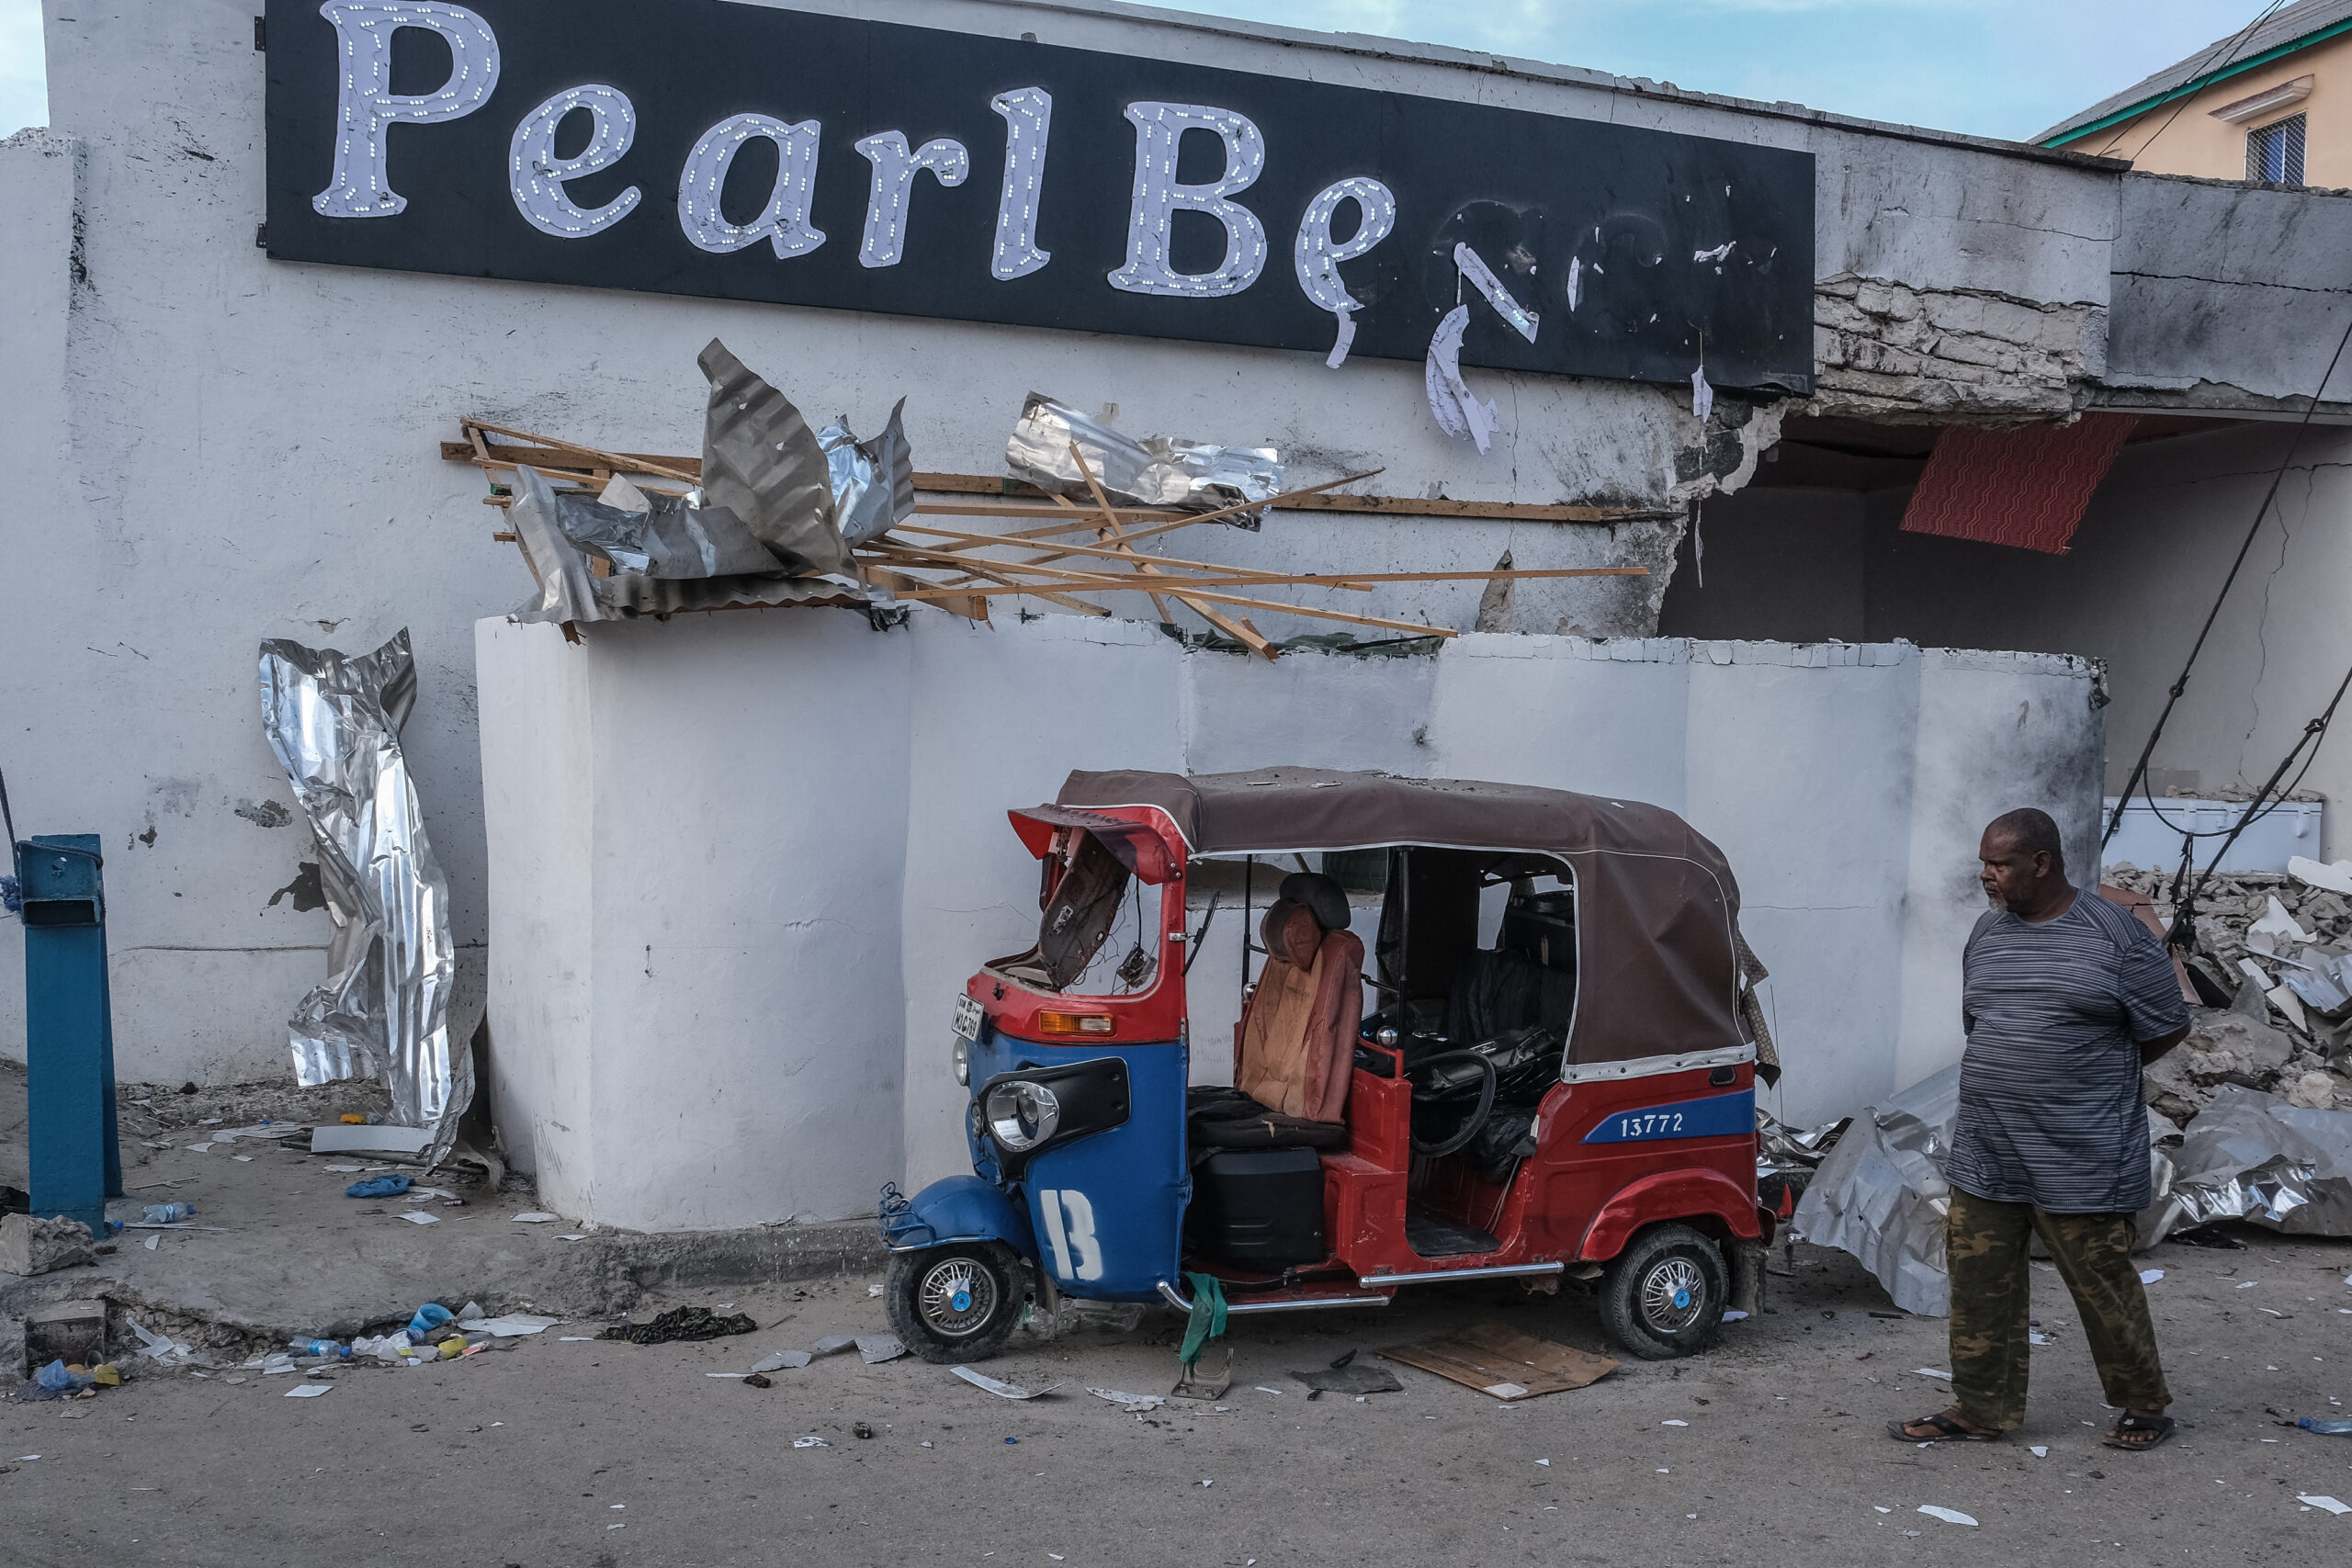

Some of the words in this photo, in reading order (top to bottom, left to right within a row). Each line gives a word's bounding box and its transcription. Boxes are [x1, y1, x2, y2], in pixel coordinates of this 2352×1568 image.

[311, 0, 1053, 281] Pearl
[1621, 1112, 1683, 1138] 13772
[1040, 1189, 1102, 1281] B
